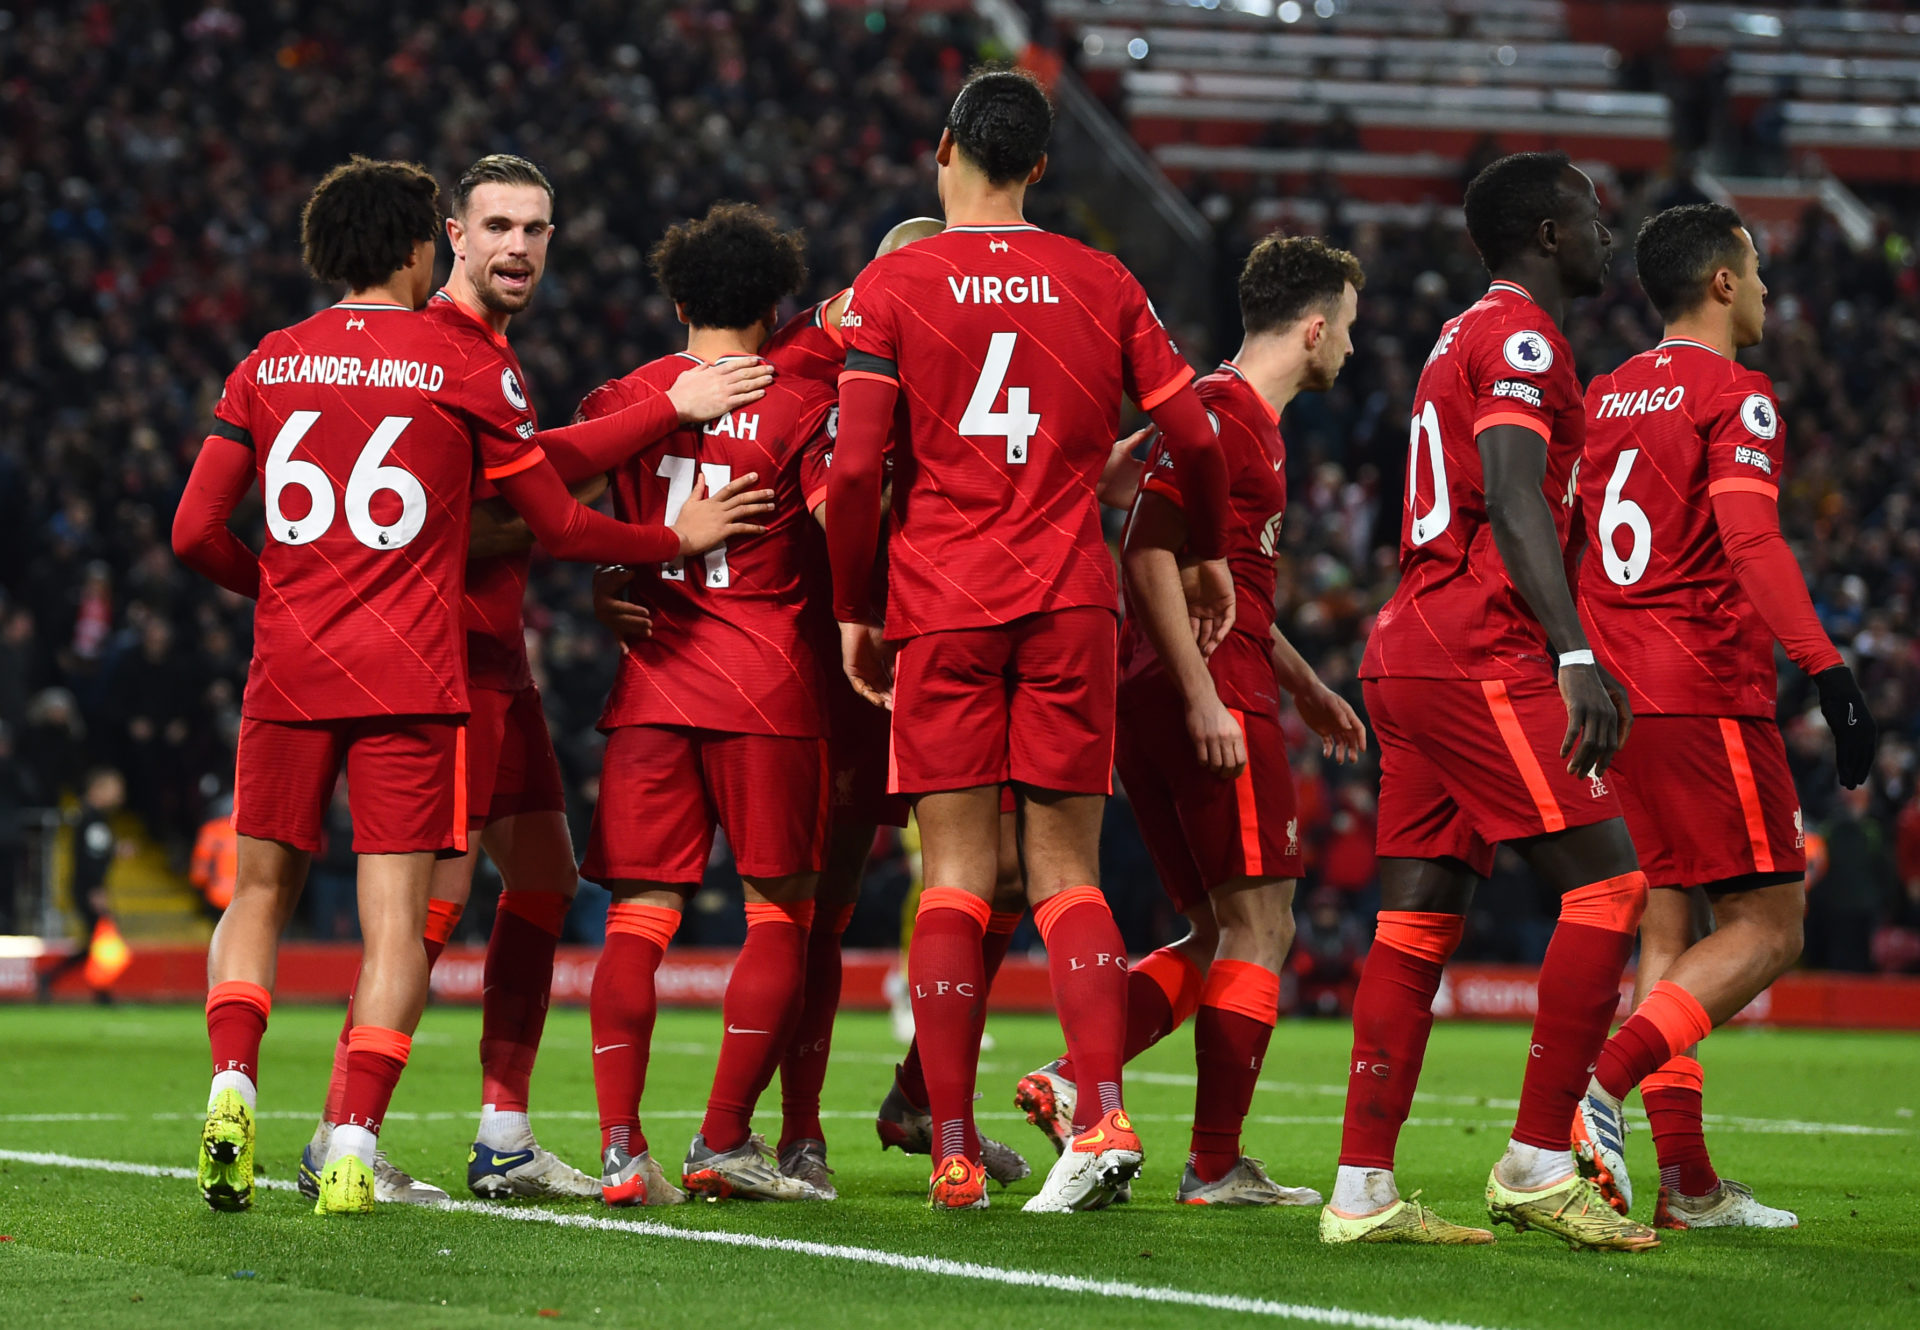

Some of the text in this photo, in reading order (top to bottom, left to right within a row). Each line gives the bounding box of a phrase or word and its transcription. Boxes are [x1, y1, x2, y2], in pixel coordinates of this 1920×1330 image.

[947, 275, 1060, 304] VIRGIL
[256, 355, 445, 392] ALEXANDER-ARNOLD
[1494, 379, 1540, 398] No room
[958, 332, 1041, 464] 4
[1595, 385, 1686, 421] THIAGO
[1735, 445, 1751, 457] No
[264, 410, 428, 551] 66
[1599, 448, 1653, 587] 6
